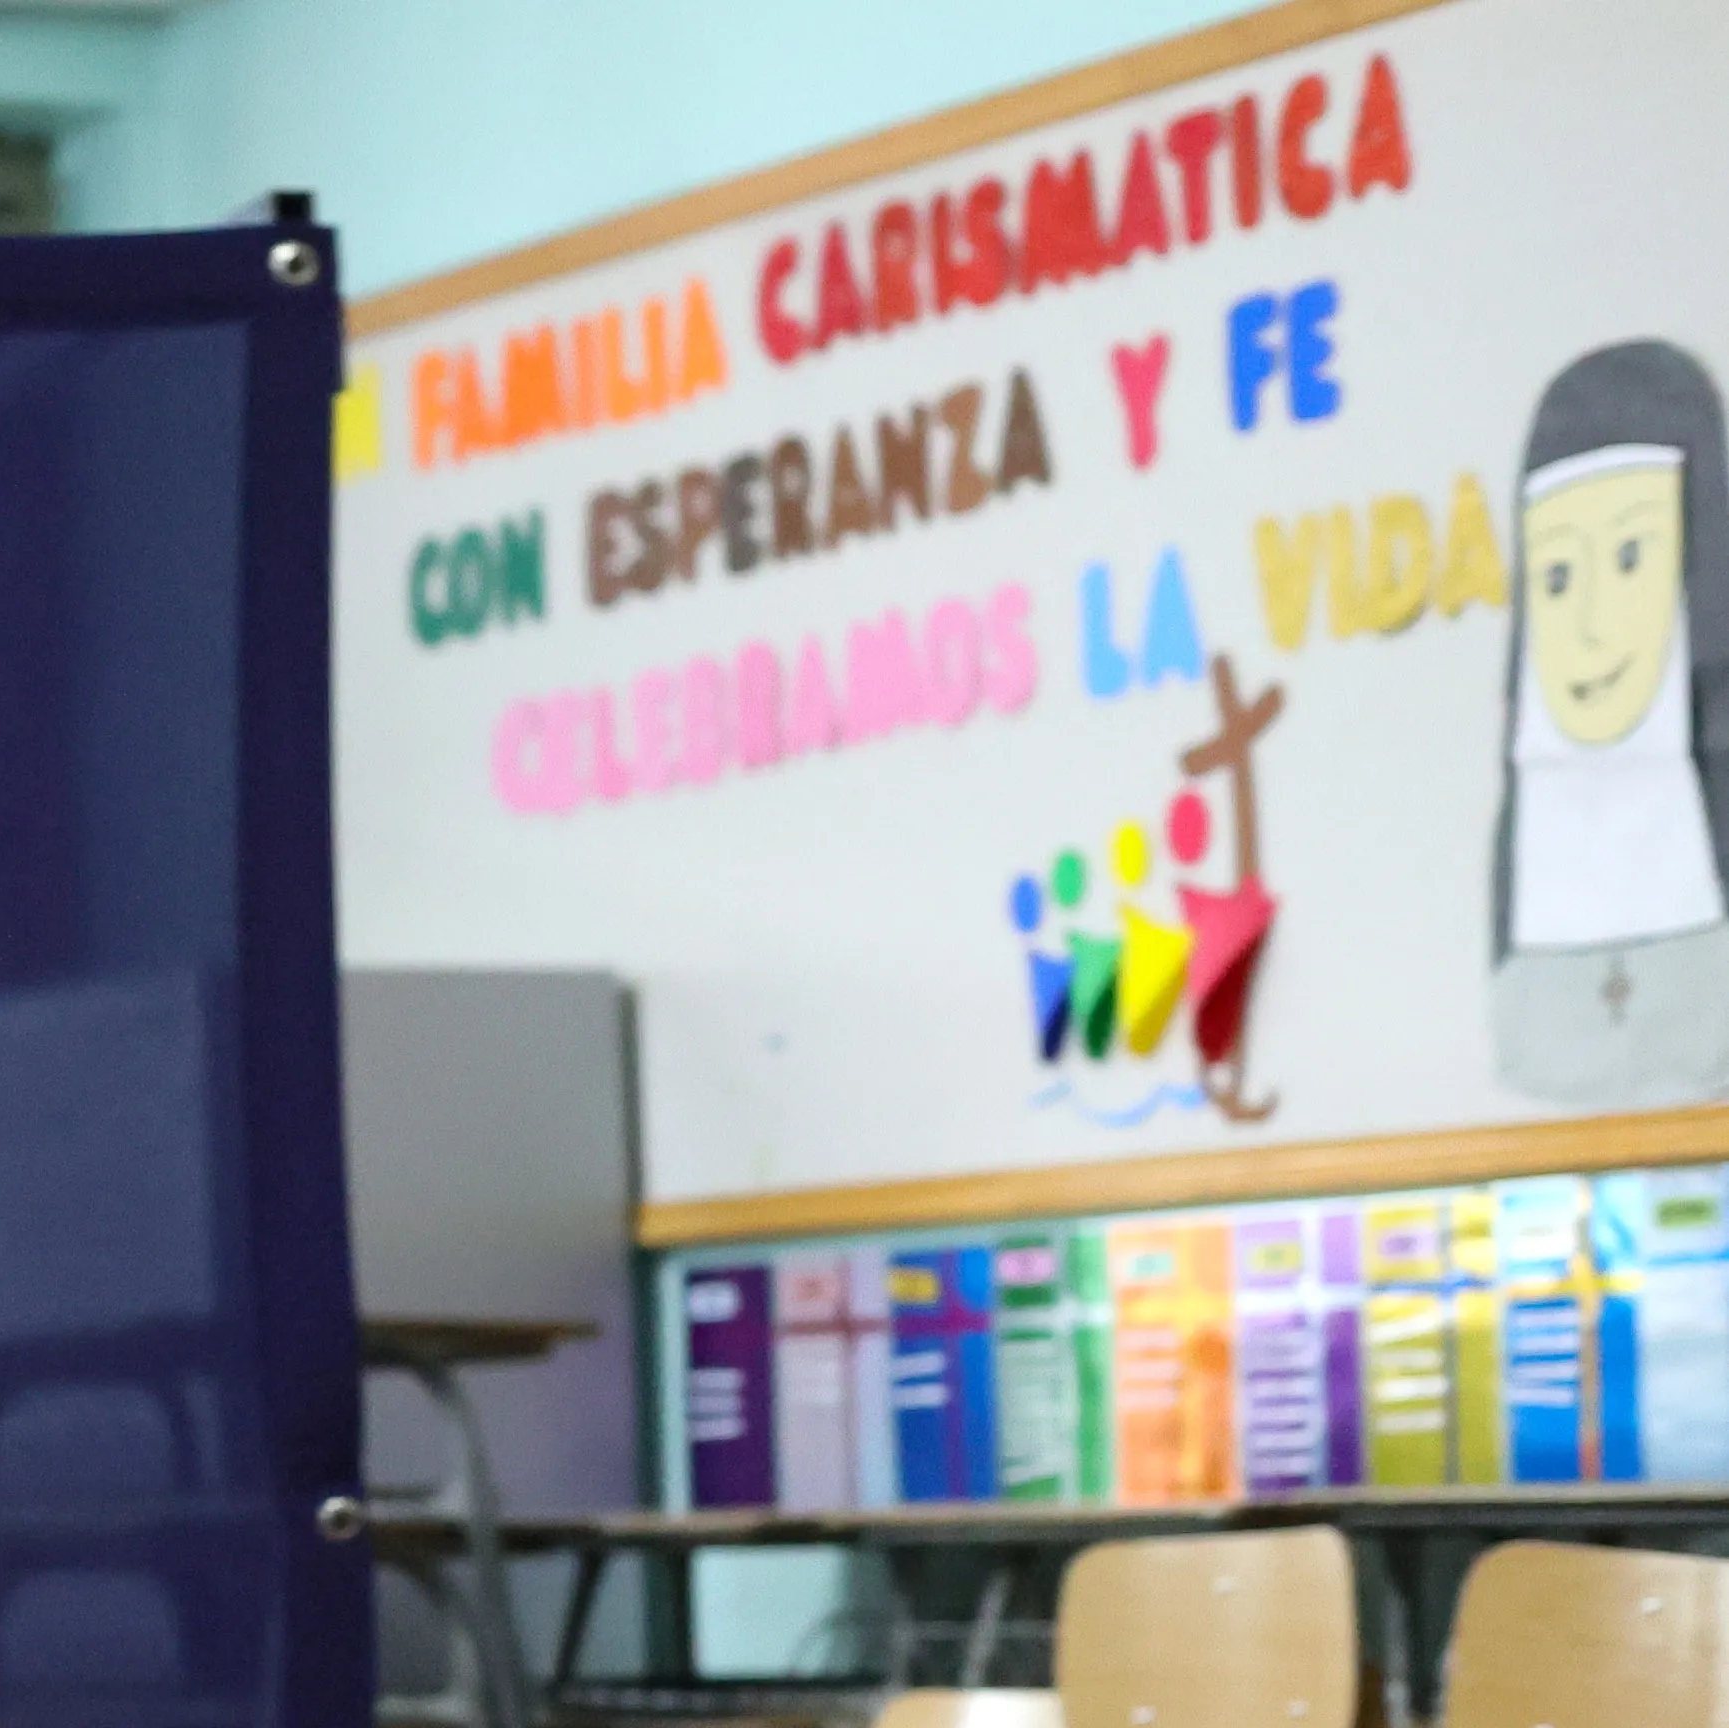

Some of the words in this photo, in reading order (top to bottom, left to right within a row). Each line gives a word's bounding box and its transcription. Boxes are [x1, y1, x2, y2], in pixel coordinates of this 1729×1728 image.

[412, 278, 729, 472] FAMILIA
[757, 53, 1413, 363] CARISMATICA
[409, 510, 548, 648] CON
[588, 368, 1054, 607] ESPERANZA
[1110, 334, 1171, 470] Y
[1227, 281, 1343, 432] FE
[491, 582, 1039, 816] CELEBRAMOS
[1080, 546, 1206, 700] LA
[1254, 473, 1511, 651] VIDA
